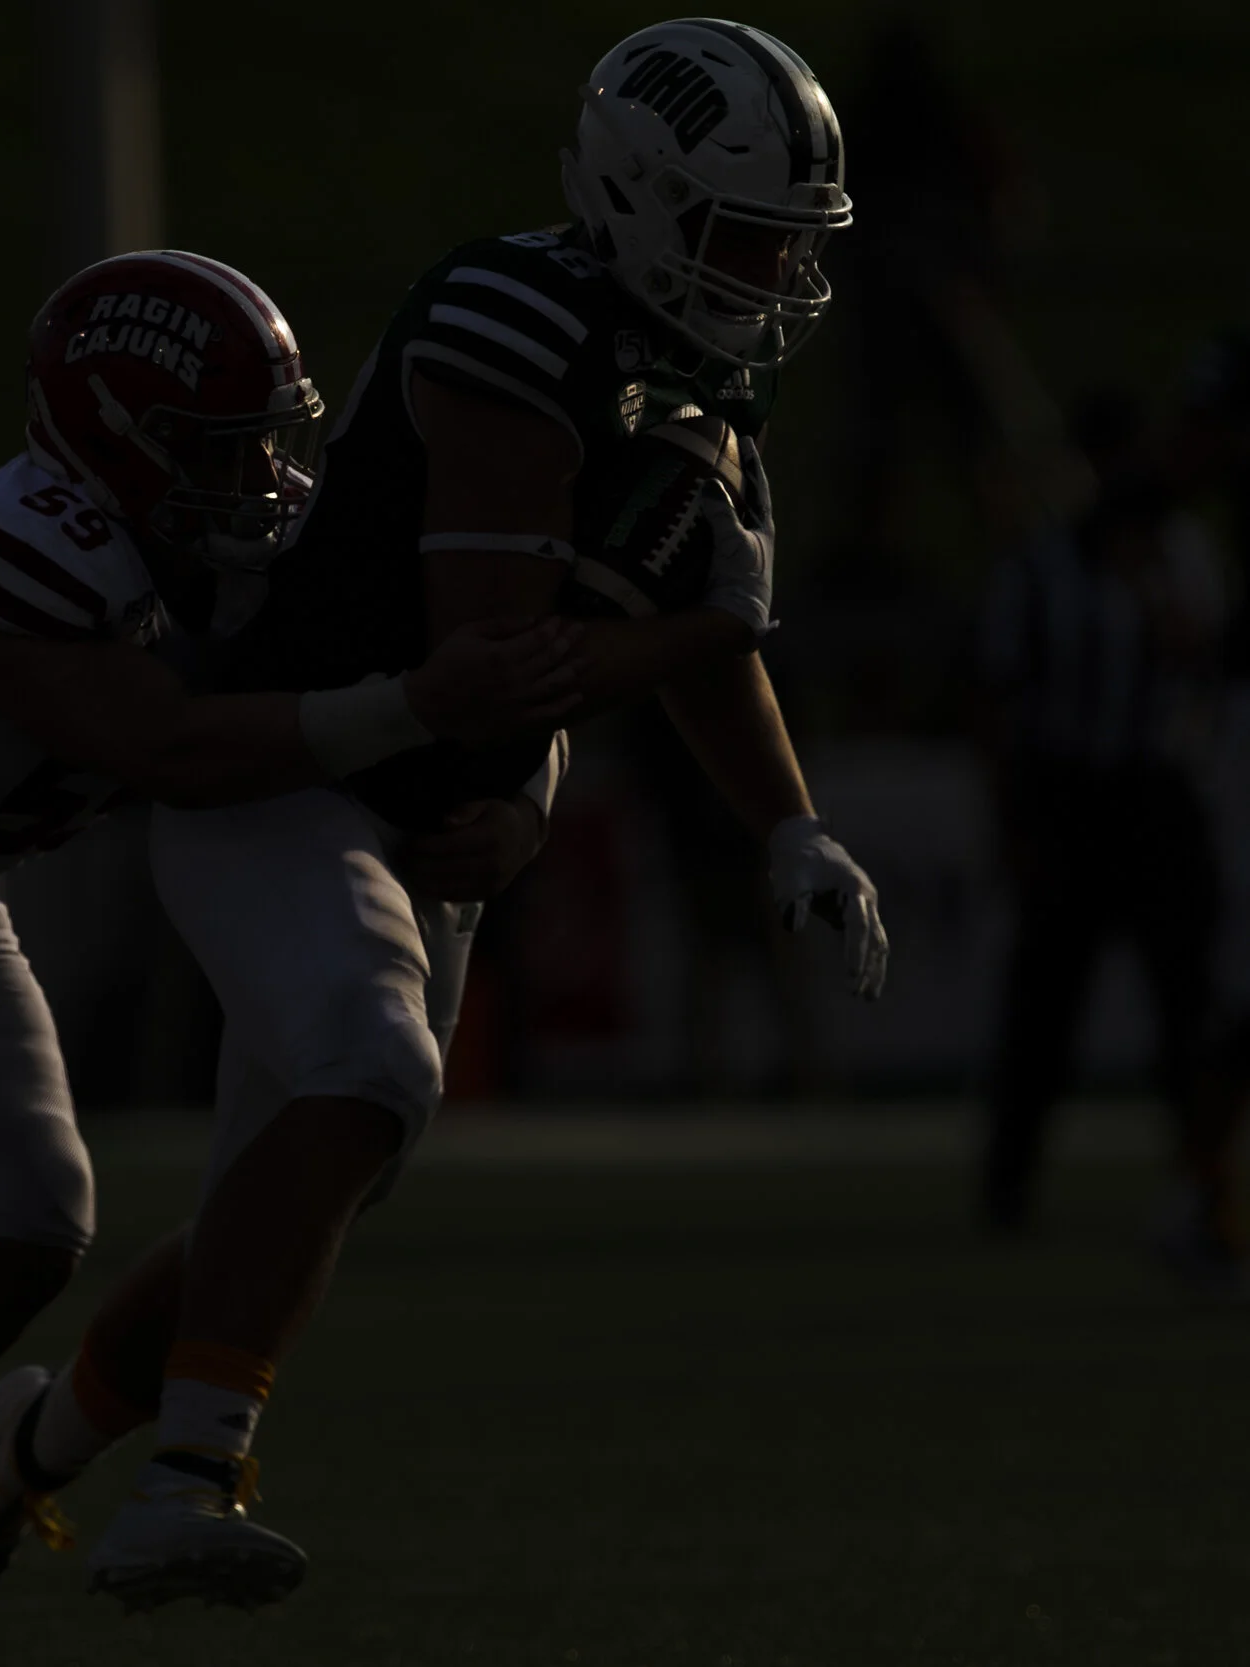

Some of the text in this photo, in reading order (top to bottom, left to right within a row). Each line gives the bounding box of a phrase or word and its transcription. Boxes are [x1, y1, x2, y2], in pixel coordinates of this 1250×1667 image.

[616, 51, 729, 155] OHIO
[64, 324, 205, 394] CAJUNS
[21, 486, 114, 551] 59
